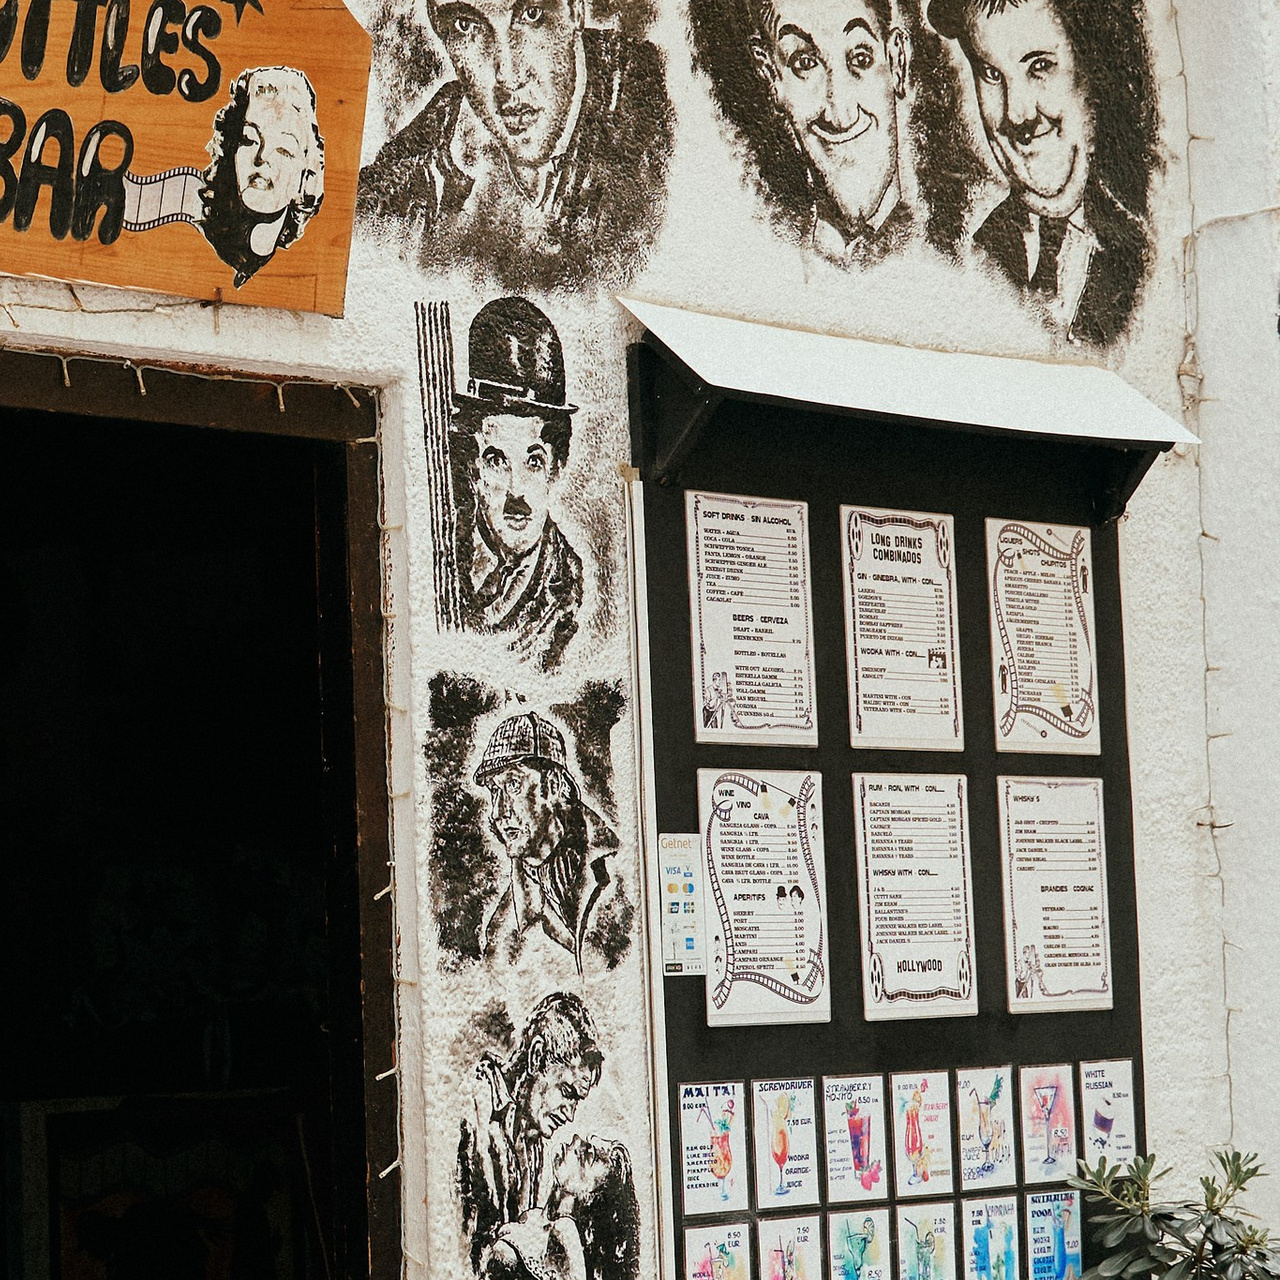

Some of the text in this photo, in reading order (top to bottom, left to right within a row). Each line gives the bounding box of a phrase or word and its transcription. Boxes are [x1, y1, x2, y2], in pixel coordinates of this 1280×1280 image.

[703, 511, 720, 519] SOFT
[721, 513, 745, 521] DRINKS
[763, 517, 792, 526] ALCOHOL
[871, 533, 923, 549] LONG DRINKS
[873, 548, 922, 564] COMBINADOS
[1022, 548, 1040, 556] SHOTS
[1041, 559, 1067, 568] CHUPITOS
[901, 576, 917, 584] WITH
[733, 614, 789, 624] BEERS CERVEZA
[860, 647, 883, 656] WODKA
[885, 649, 900, 657] WITH
[661, 838, 692, 848] Getnet
[665, 866, 681, 874] VISA
[733, 893, 766, 901] APERITIFS
[896, 959, 943, 973] HOLLYWOOD
[1084, 1070, 1105, 1079] WHITE
[759, 1080, 813, 1092] SCREWDRIVER
[826, 1082, 872, 1094] STRAWBERRY
[1085, 1081, 1113, 1090] RUSSIAN
[826, 1092, 853, 1102] MOJITO
[728, 1240, 740, 1248] EUR
[796, 1235, 809, 1243] EUR
